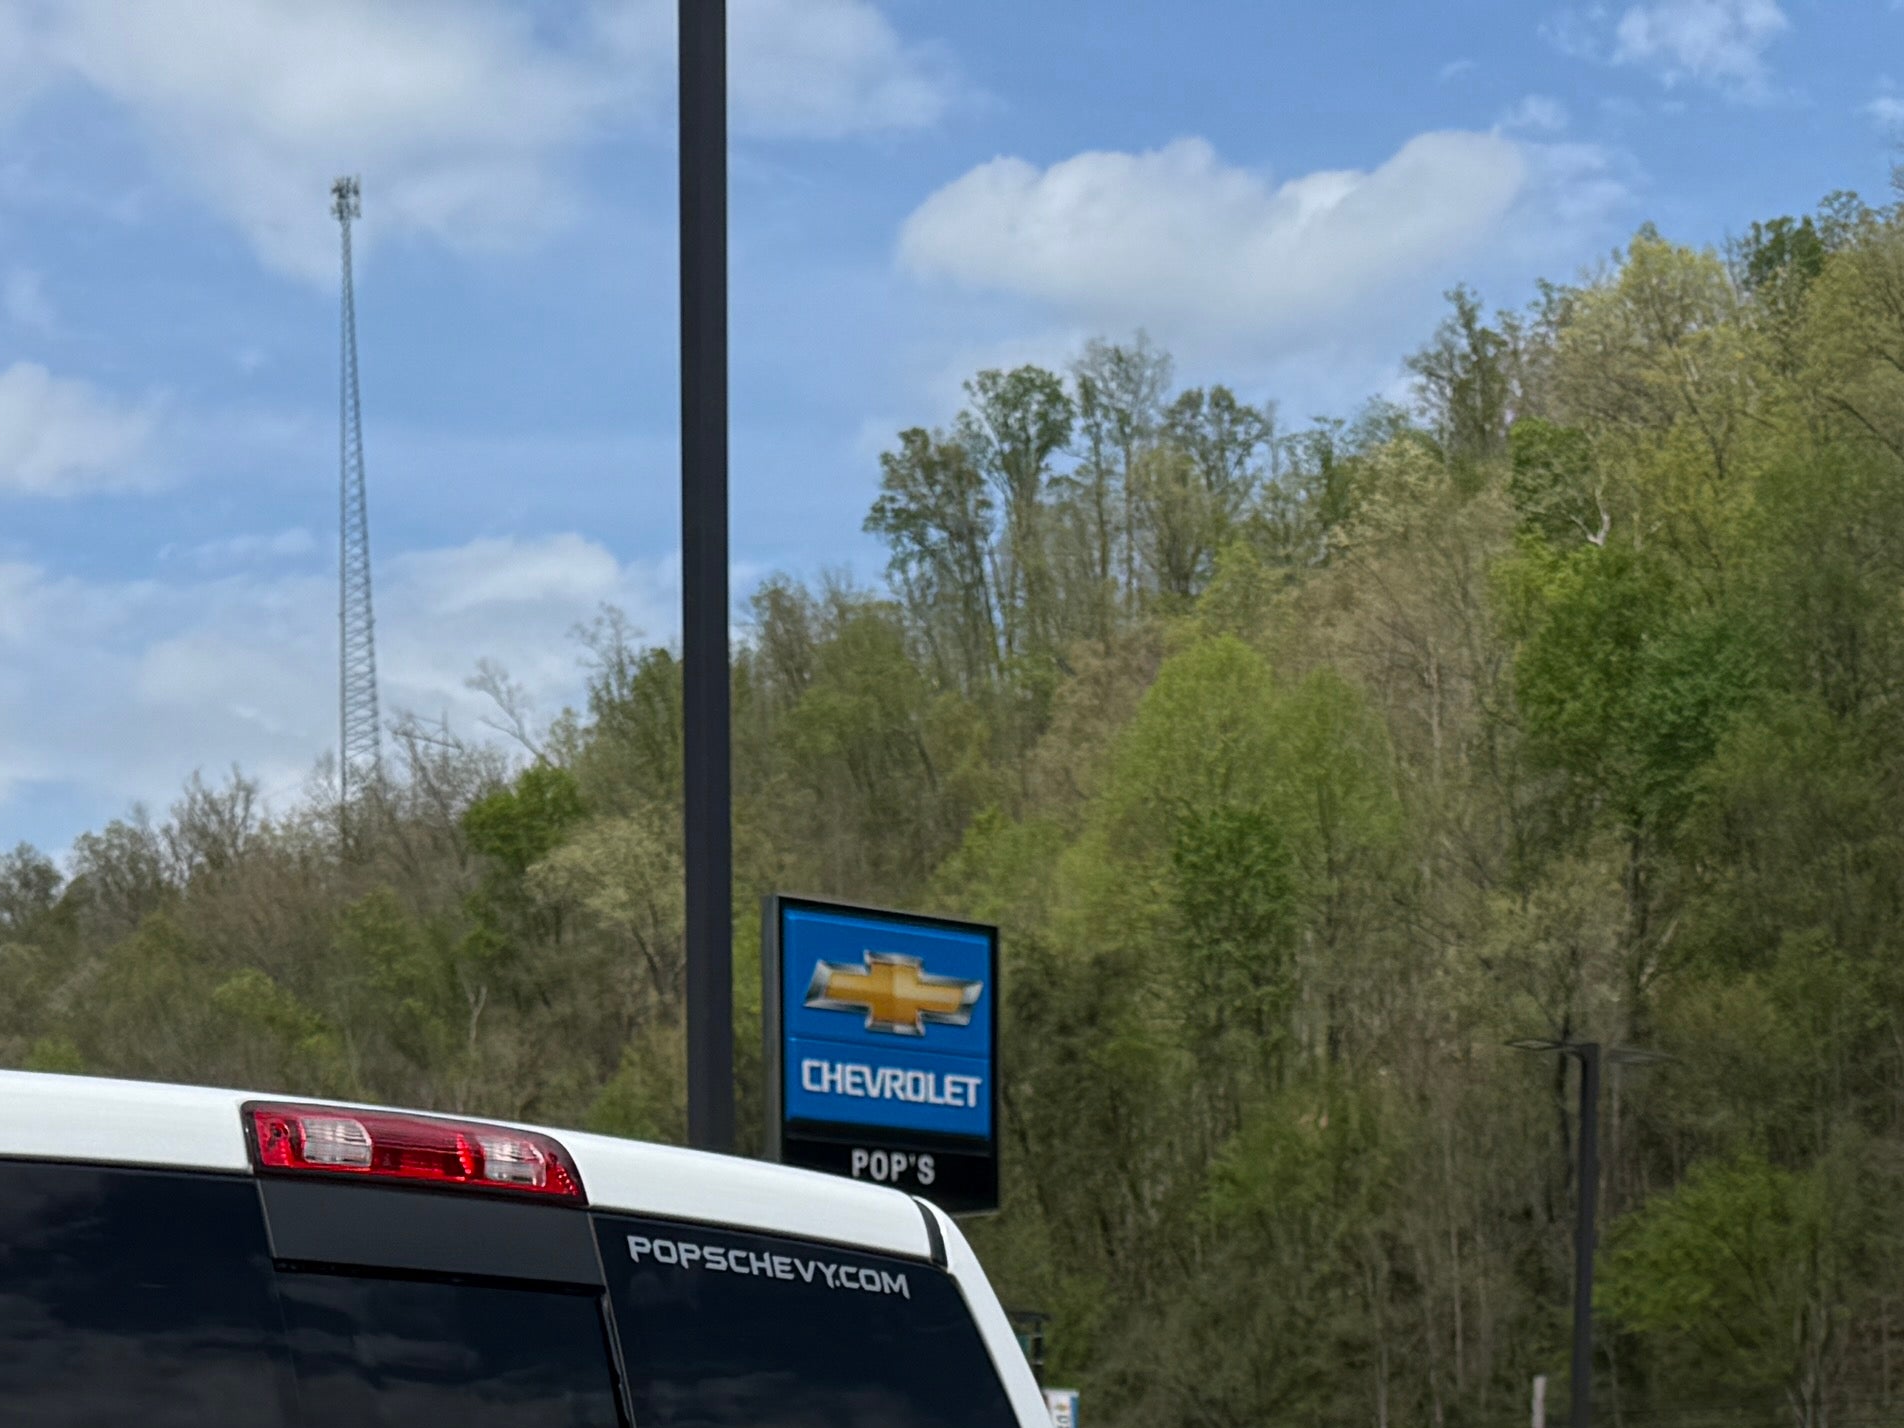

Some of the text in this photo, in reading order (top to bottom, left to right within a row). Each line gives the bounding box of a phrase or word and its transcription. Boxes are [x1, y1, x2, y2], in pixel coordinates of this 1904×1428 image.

[801, 1058, 983, 1108] CHEVROLET
[851, 1148, 936, 1185] POP'S
[626, 1235, 910, 1300] POPSCHEVY.COM
